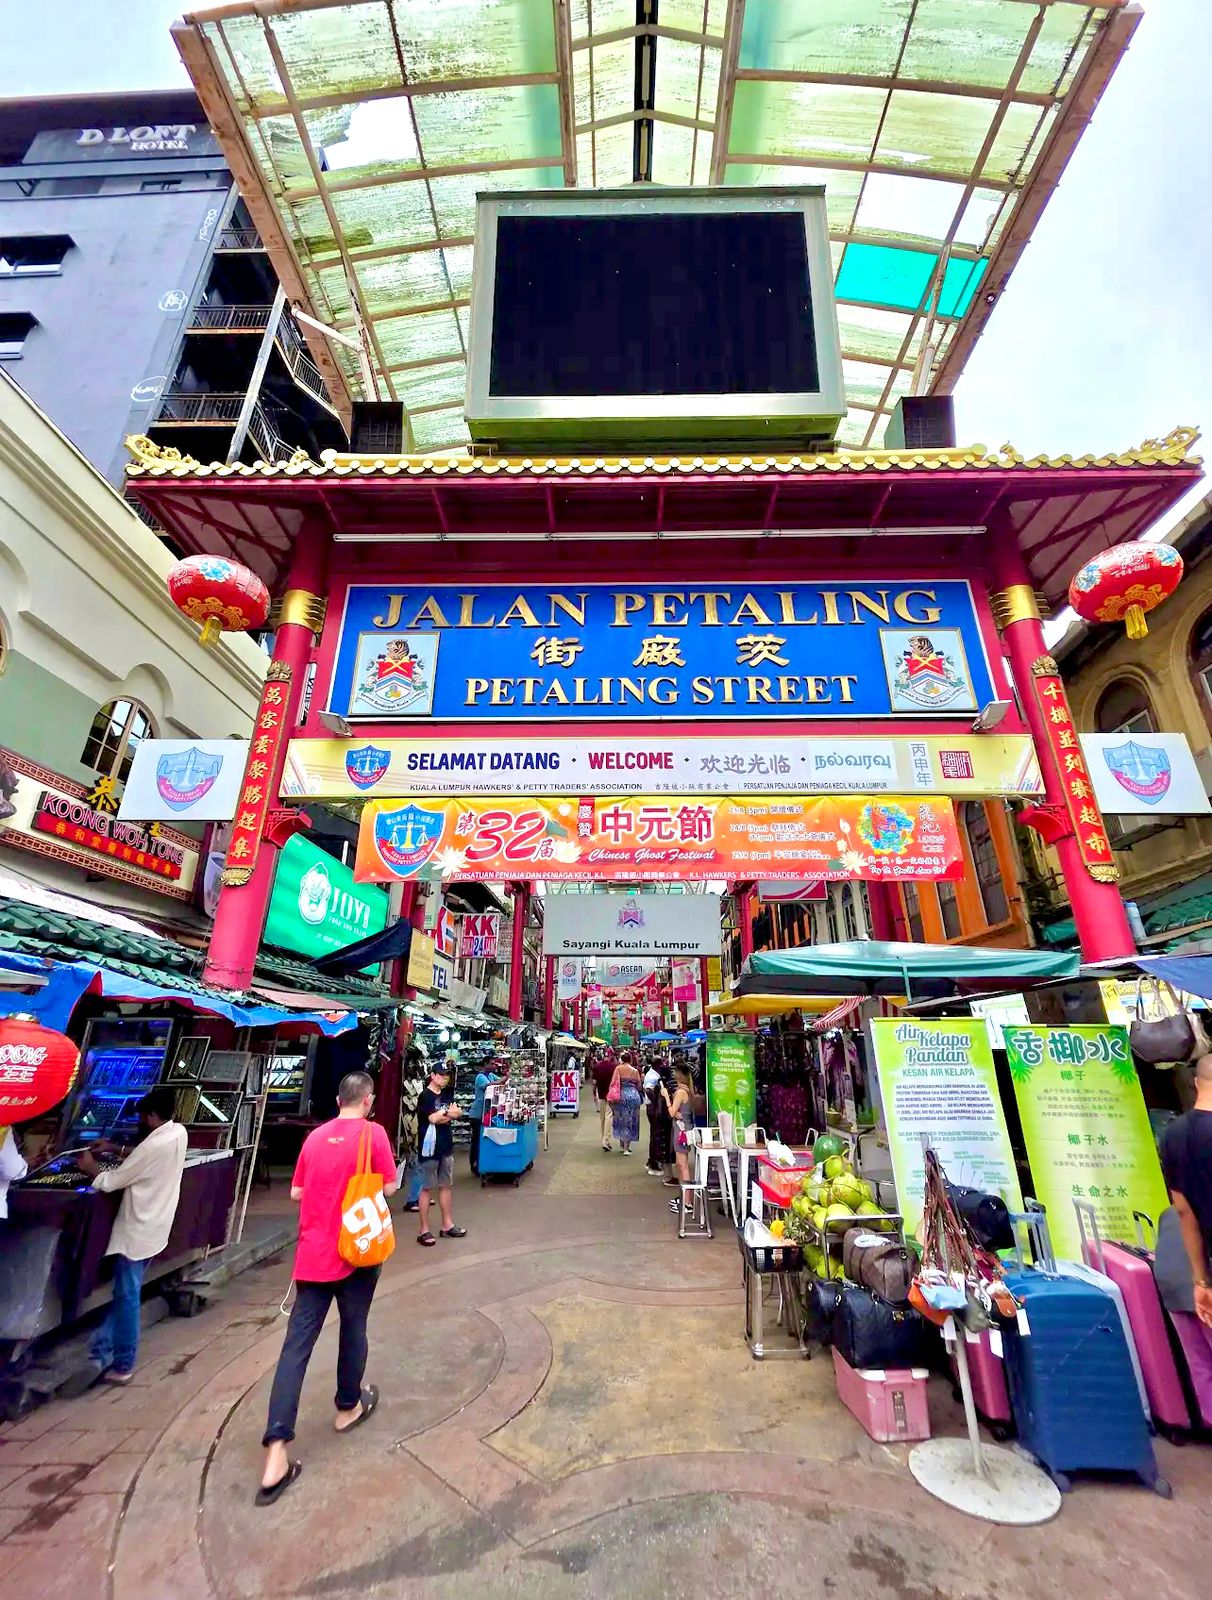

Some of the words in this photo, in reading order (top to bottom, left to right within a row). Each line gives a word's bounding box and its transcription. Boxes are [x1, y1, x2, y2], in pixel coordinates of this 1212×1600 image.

[76, 128, 105, 146] D
[108, 124, 196, 144] LOFT
[130, 140, 188, 151] HOTEL
[372, 594, 591, 628] JALAN
[608, 590, 943, 627] PETALING
[463, 676, 681, 707] PETALING
[691, 675, 858, 705] STREET
[407, 752, 487, 771] SELAMAT
[490, 752, 560, 771] DATANG
[588, 751, 674, 770] WELCOME
[700, 753, 791, 775] 欢迎光临
[910, 743, 932, 787] 丙申年
[515, 783, 521, 791] &
[523, 783, 548, 791] PETTY
[743, 782, 774, 790] PERSATUAN
[42, 792, 108, 833] KOONG
[113, 820, 149, 851] WOH
[151, 837, 185, 865] TONG
[600, 805, 714, 842] 中元節
[588, 849, 631, 861] Chinese
[634, 848, 666, 863] Ghost
[669, 848, 716, 861] Festival
[454, 872, 495, 880] PERSATUAN
[496, 872, 525, 880] PENJAJA
[769, 871, 800, 879] TRADERS
[803, 871, 850, 879] ASSOCIATION
[465, 915, 495, 936] KK
[474, 937, 483, 956] 24
[562, 939, 611, 951] Sayangi
[614, 939, 650, 949] Kuala
[654, 940, 701, 951] Lumpur
[895, 1024, 920, 1043] Air
[918, 1030, 971, 1050] Kelapa
[905, 1046, 967, 1065] Pandan
[1012, 1029, 1128, 1066] 香椰水
[553, 1072, 576, 1088] KK
[902, 1068, 928, 1077] KESAN
[930, 1068, 944, 1077] AIR
[944, 1068, 975, 1077] KELAPA
[1061, 1070, 1086, 1081] 椰子
[1067, 1133, 1109, 1146] 椰子水
[1072, 1184, 1129, 1198] 生命之水
